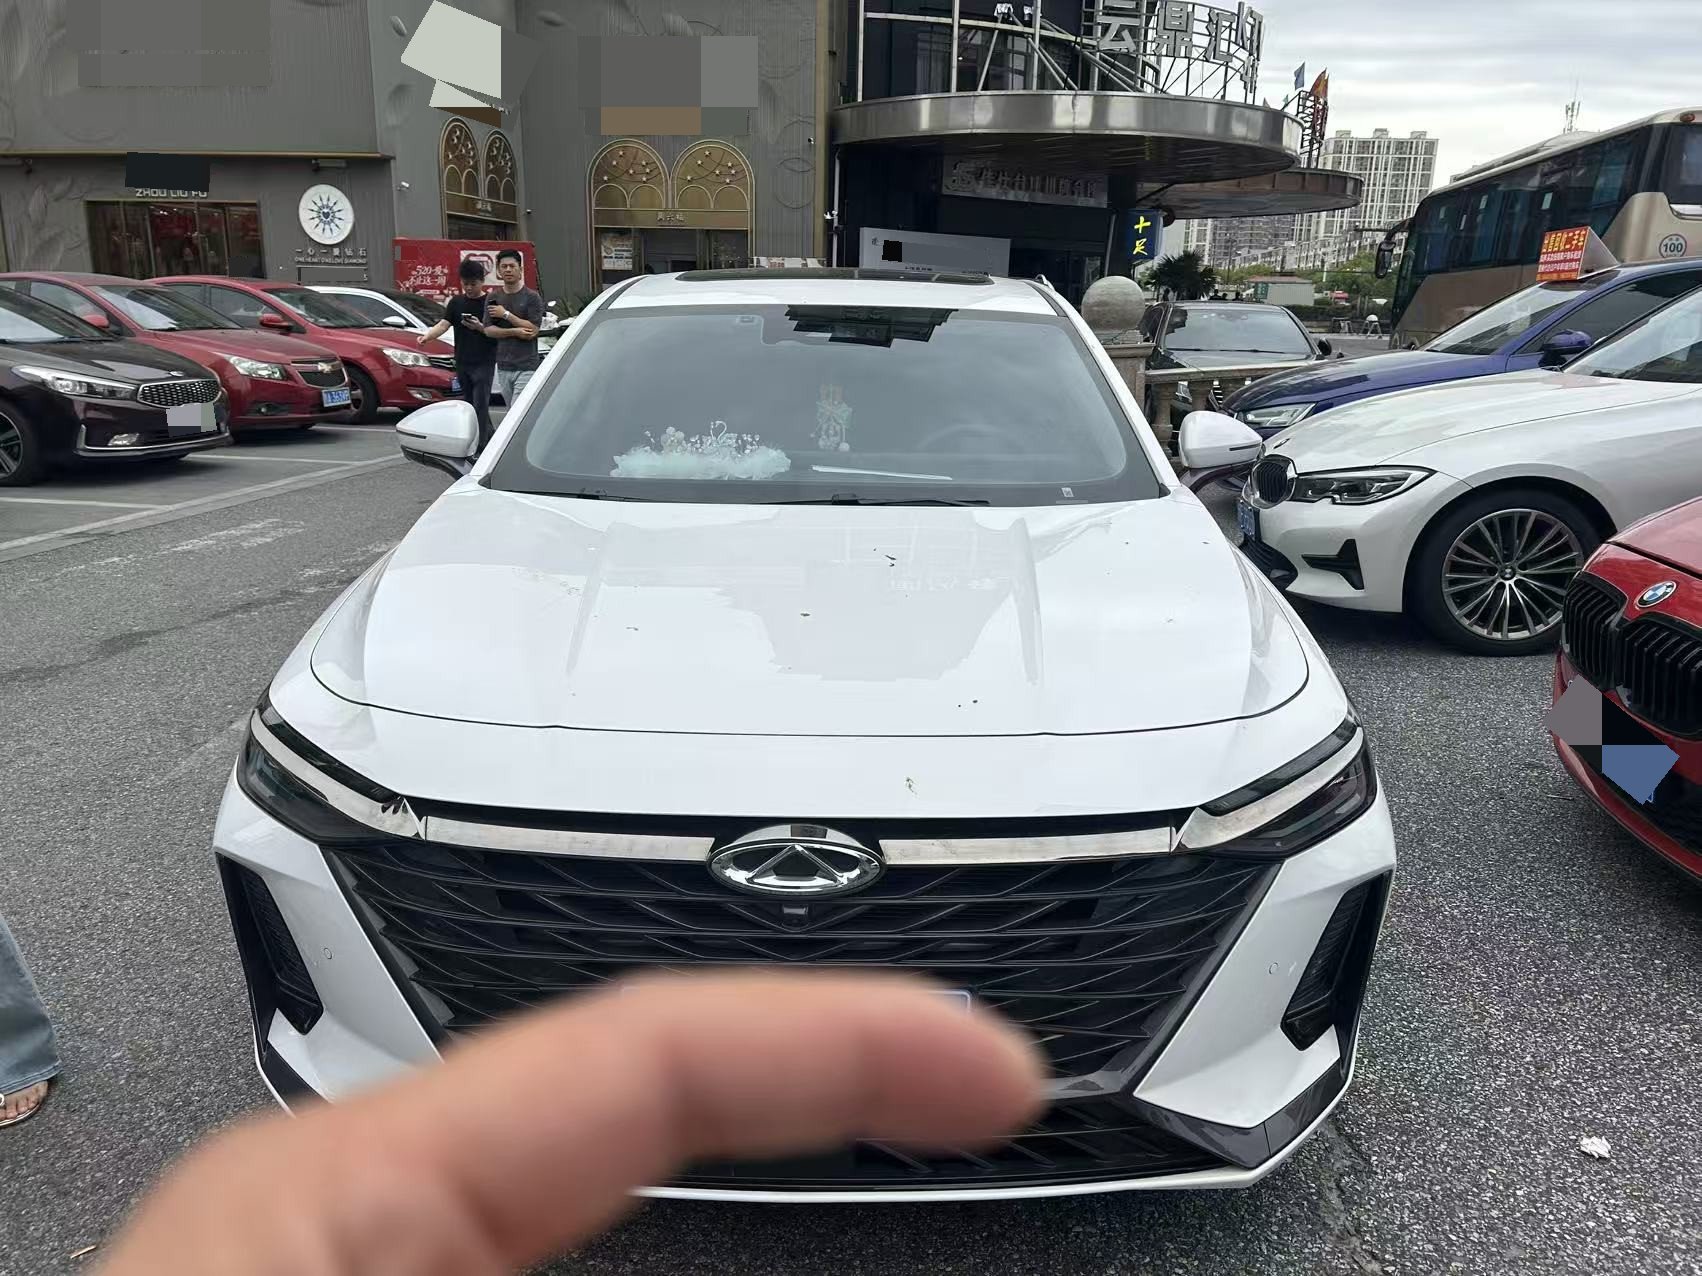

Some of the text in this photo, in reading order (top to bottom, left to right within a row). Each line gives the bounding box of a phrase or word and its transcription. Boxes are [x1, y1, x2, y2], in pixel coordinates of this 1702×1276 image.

[135, 188, 167, 197] ZHOU
[170, 189, 188, 198] LIU
[1133, 215, 1152, 256] 十足
[1663, 242, 1683, 255] 100
